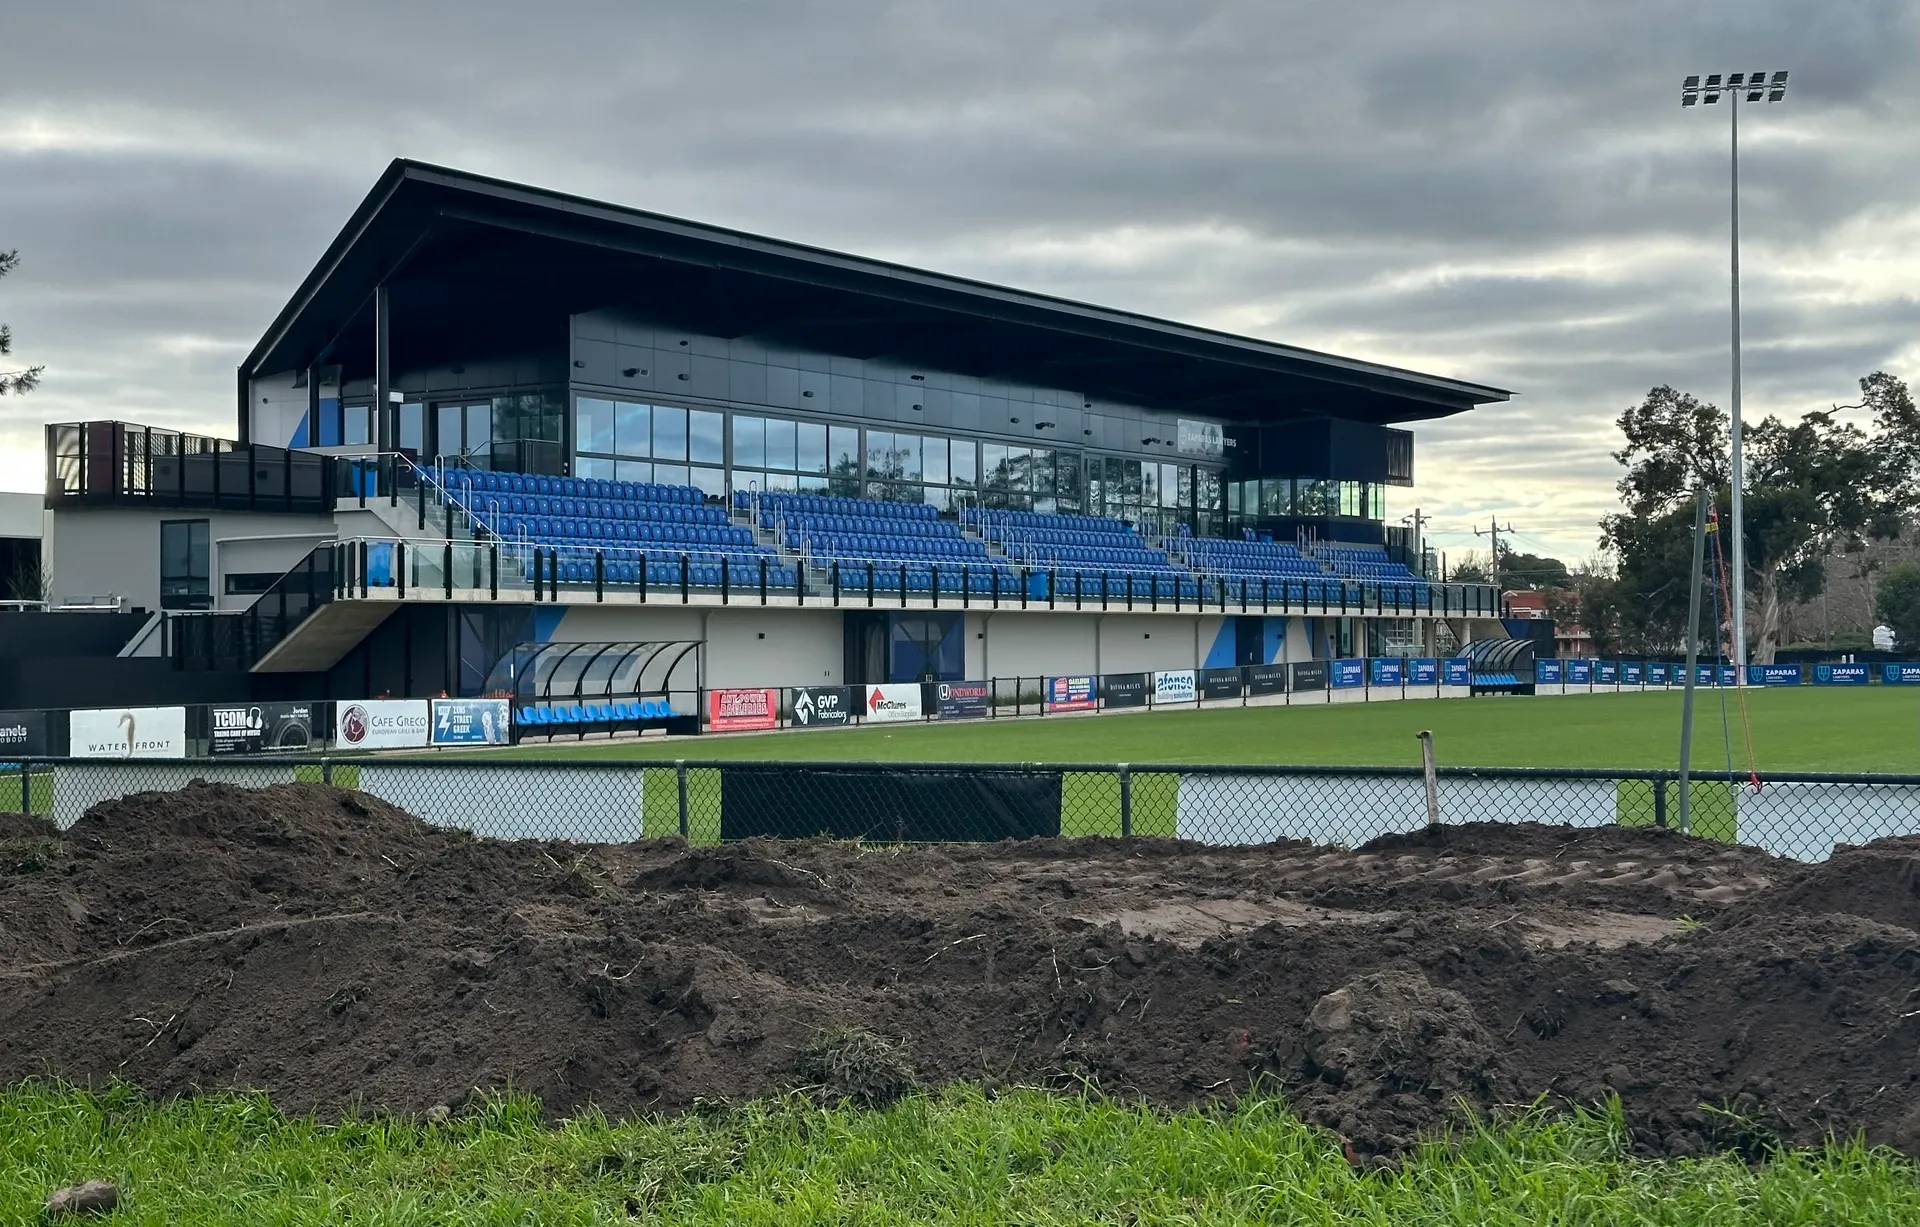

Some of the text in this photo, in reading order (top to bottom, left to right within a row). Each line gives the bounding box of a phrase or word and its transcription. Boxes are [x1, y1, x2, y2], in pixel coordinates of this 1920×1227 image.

[1187, 432, 1212, 444] ZAPARAS
[1342, 665, 1360, 674] ZAPARAS
[1381, 665, 1399, 673] ZAPARAS
[1451, 664, 1466, 672] ZAPARAS
[1157, 673, 1193, 691] afonso
[817, 695, 839, 708] GVP
[877, 701, 906, 709] McClures
[720, 702, 768, 715] BATTERIES
[214, 711, 246, 727] TCOM
[371, 715, 426, 727] CAFE GRECO
[453, 715, 473, 724] STREET
[818, 709, 846, 724] Fabricators
[0, 725, 27, 737] anels
[453, 725, 470, 734] GREEK
[88, 740, 171, 752] WATER FRONT
